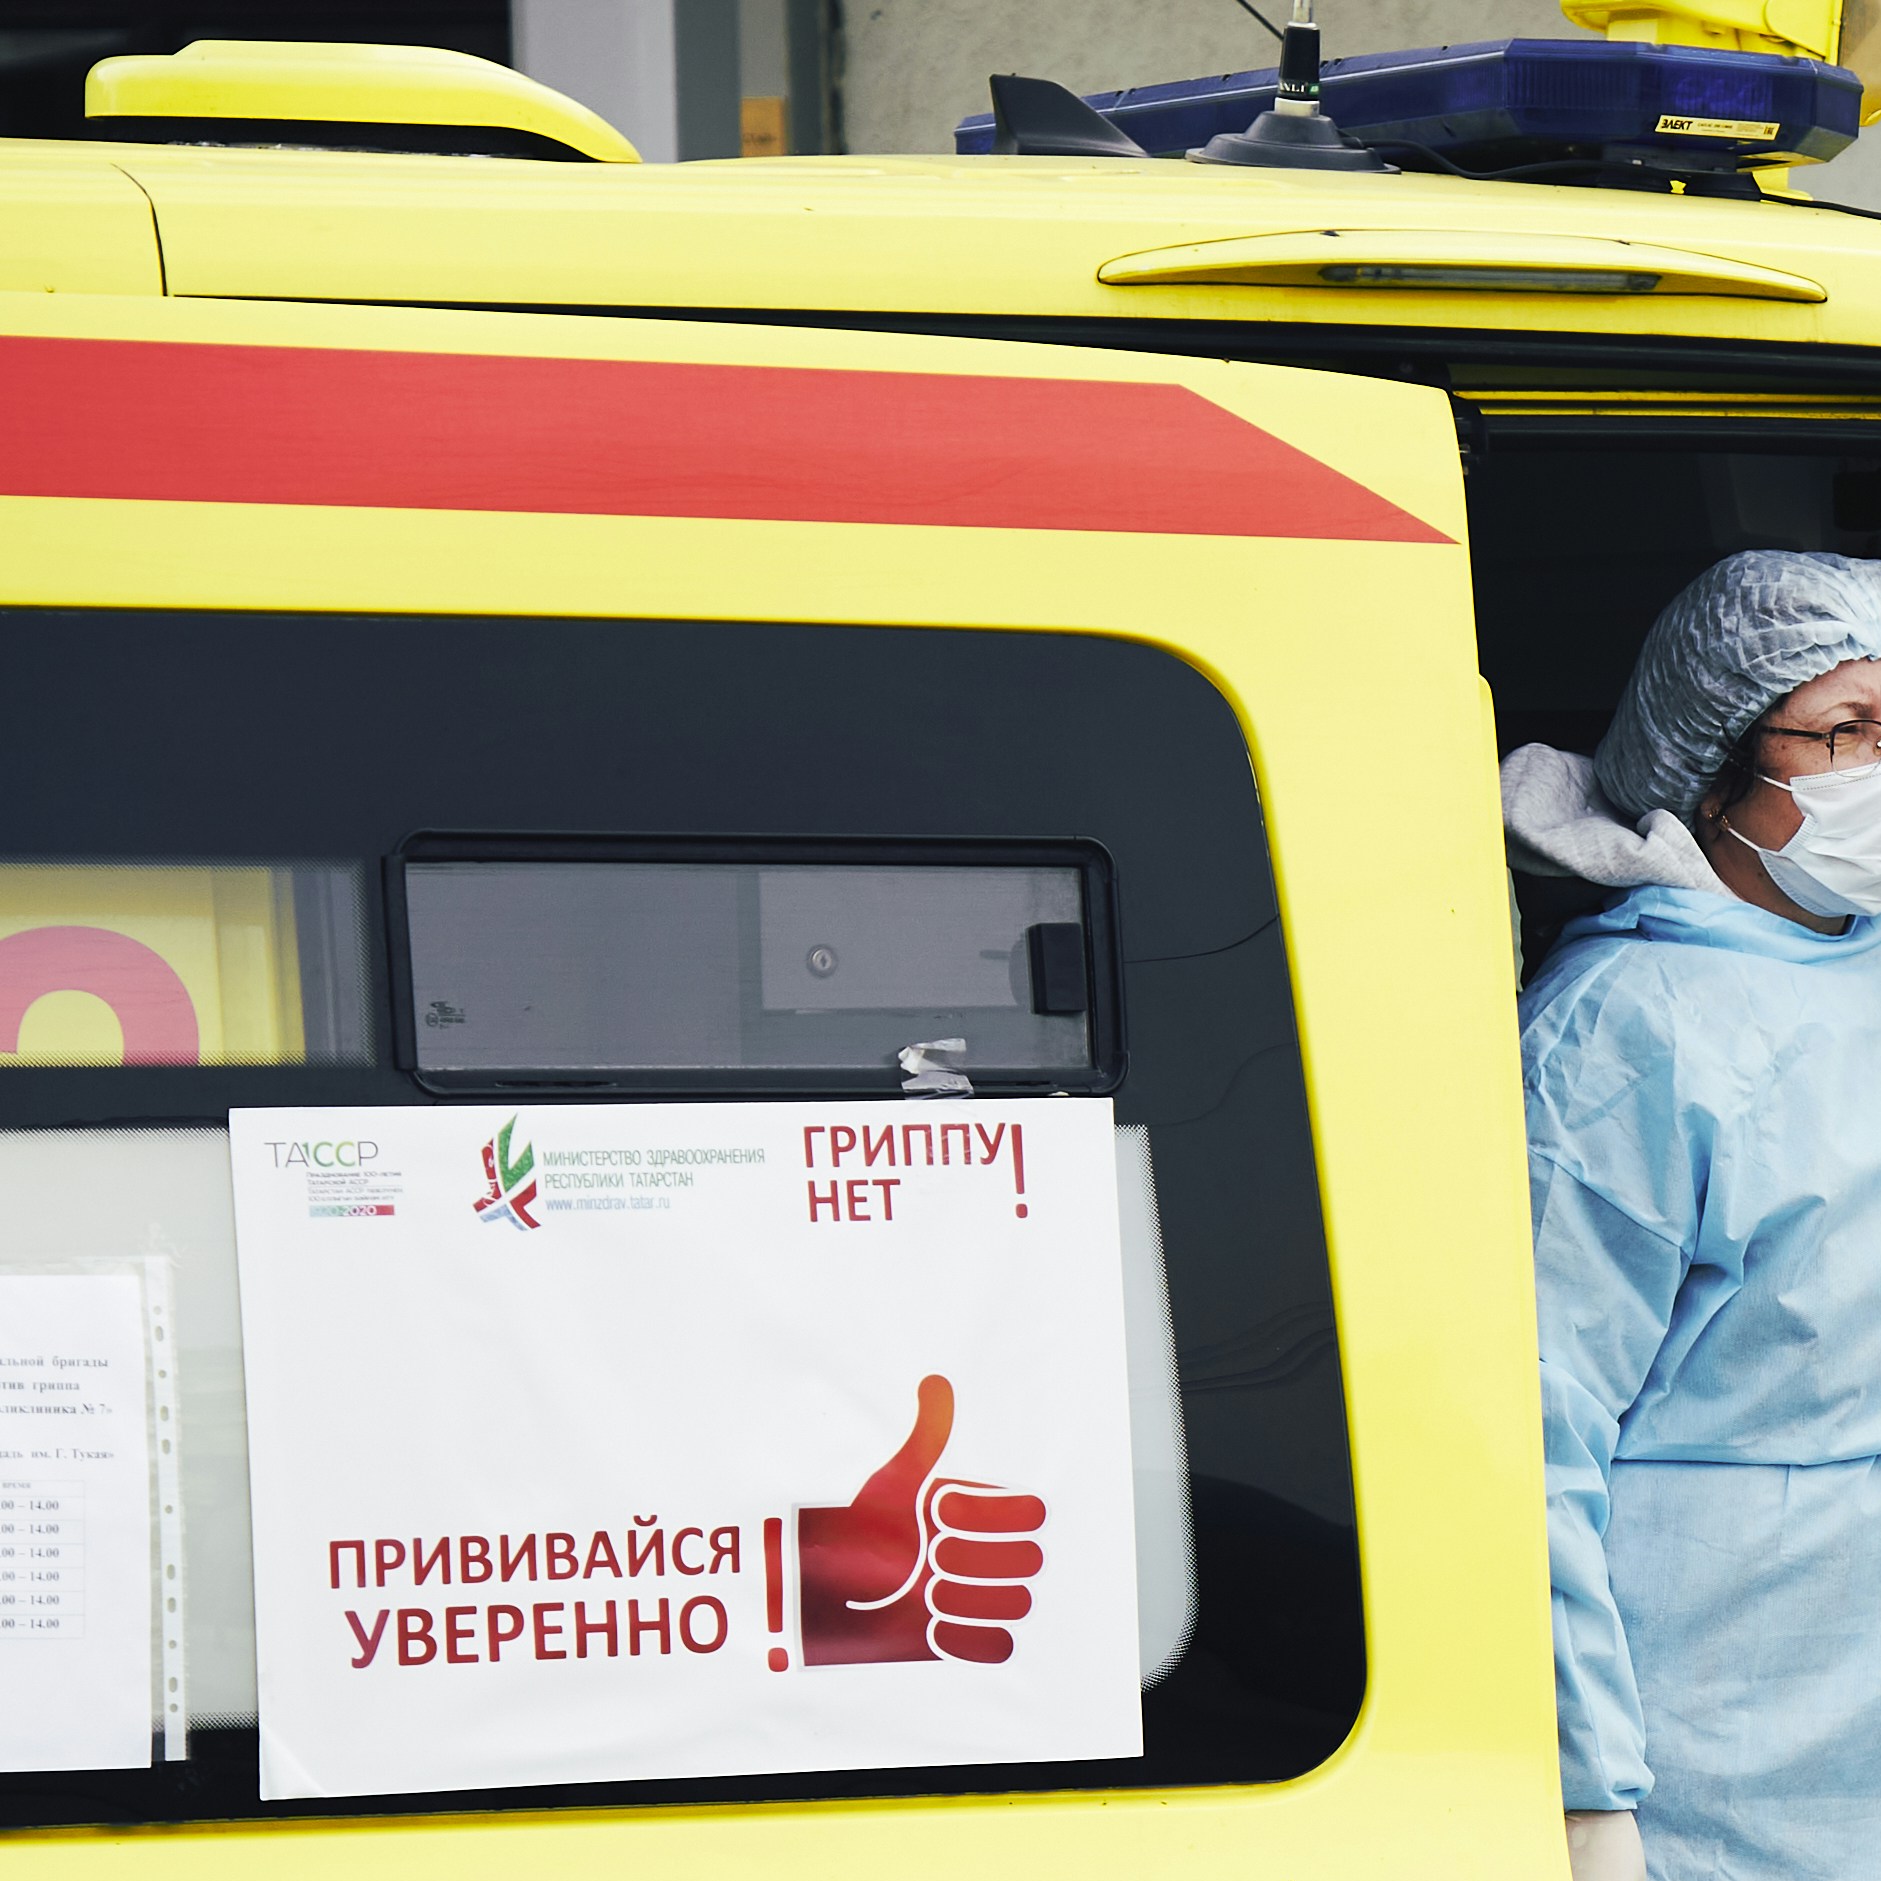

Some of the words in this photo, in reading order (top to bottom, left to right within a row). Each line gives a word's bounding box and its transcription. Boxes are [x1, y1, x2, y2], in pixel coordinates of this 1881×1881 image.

[543, 1150, 641, 1166] МИНИСТЕРСТВО
[646, 1148, 766, 1166] ЗДРАВООХРАНЕНИЯ
[544, 1173, 625, 1189] РЕСПУБЛИКИ
[629, 1172, 694, 1188] ТАТАРСТАН
[807, 1178, 901, 1222] НЕТ
[329, 1514, 741, 1589] ПРИВИВАЙСЯ
[344, 1595, 729, 1669] УВЕРЕННО
